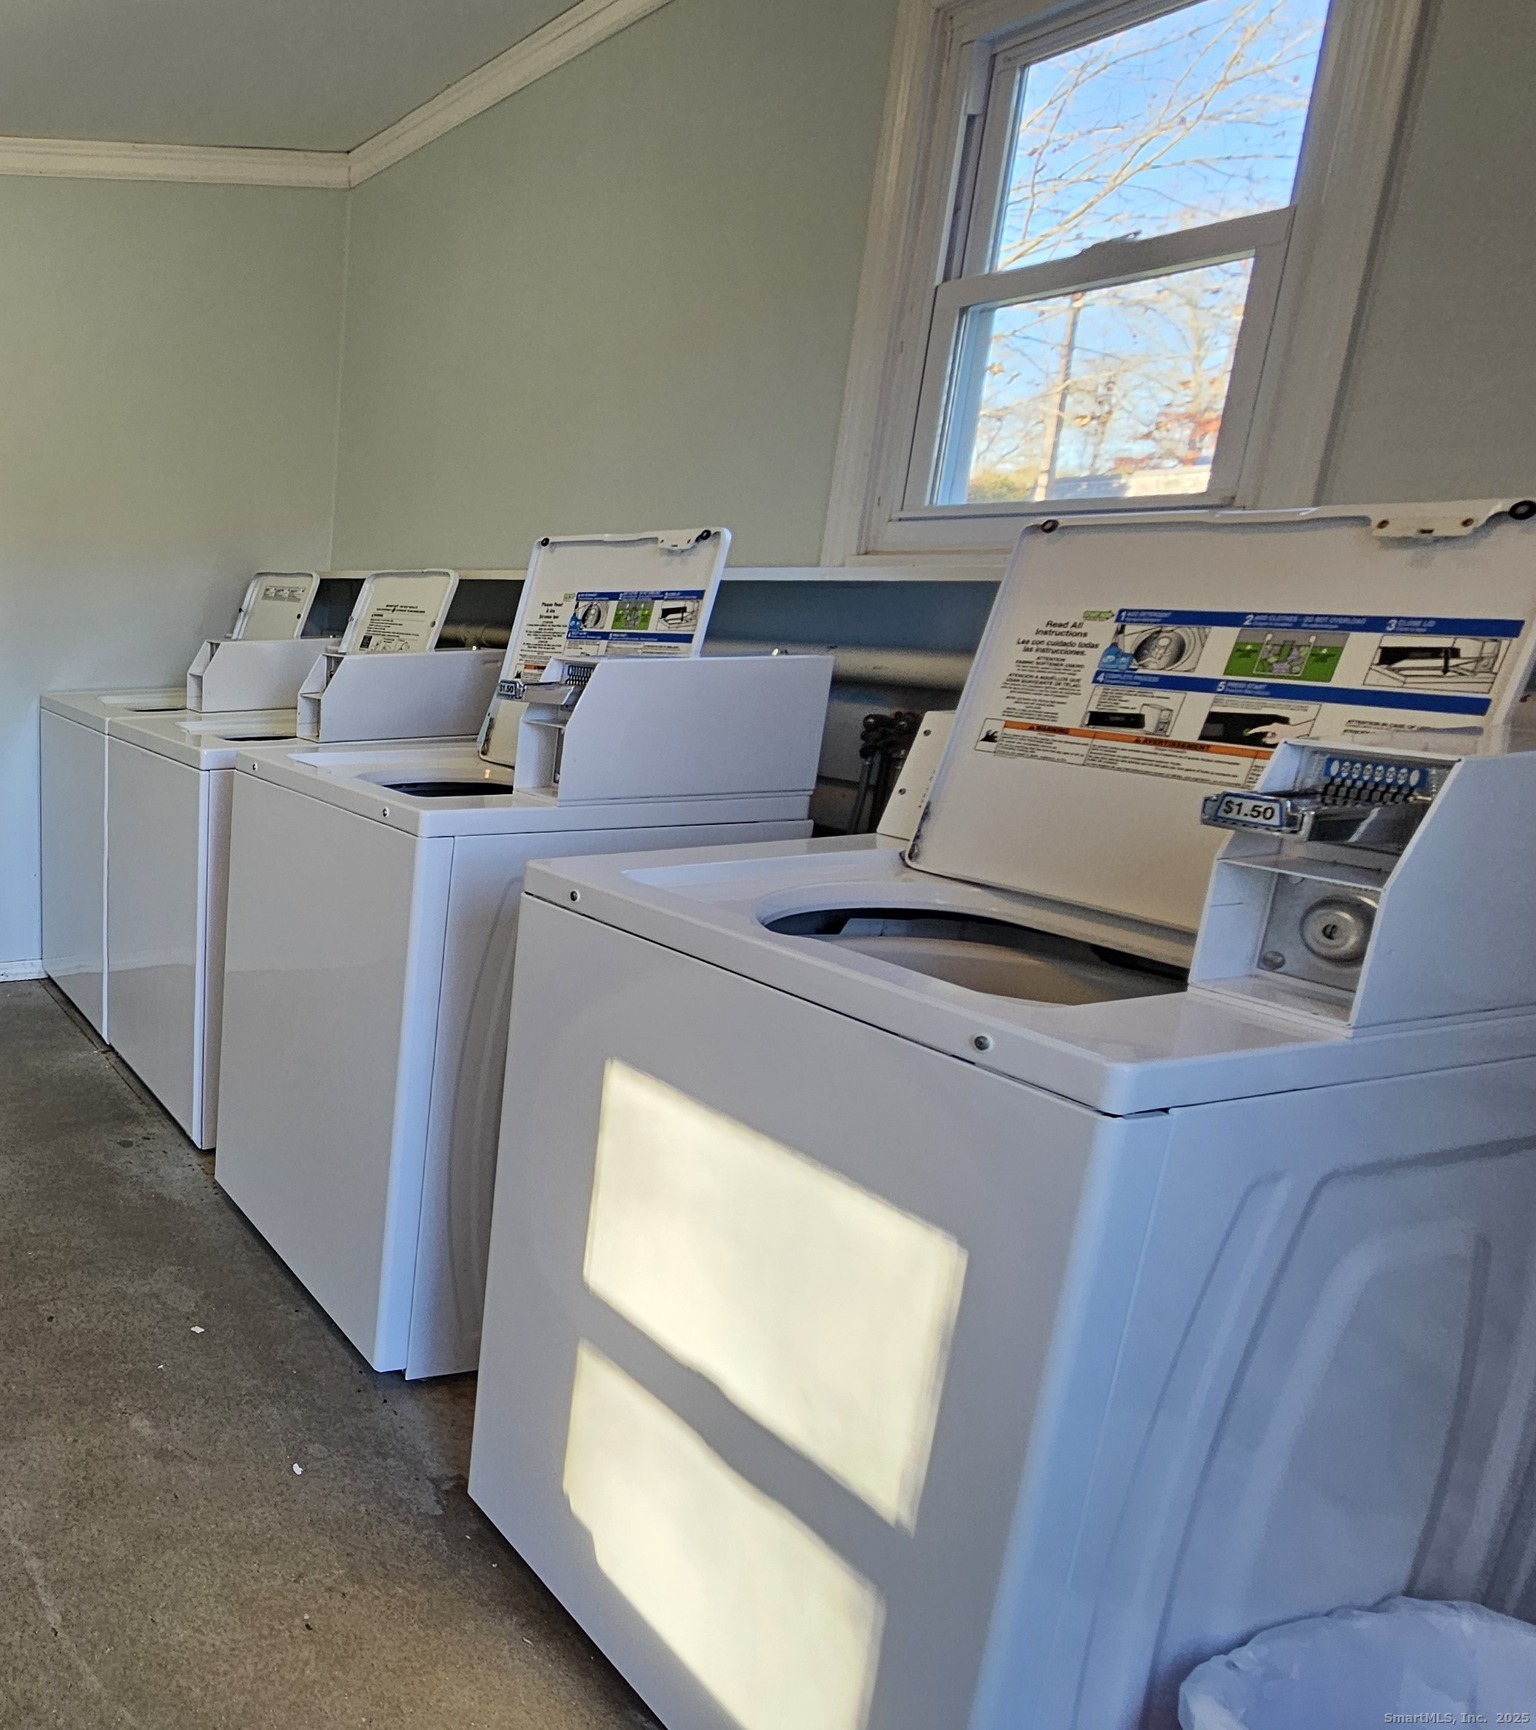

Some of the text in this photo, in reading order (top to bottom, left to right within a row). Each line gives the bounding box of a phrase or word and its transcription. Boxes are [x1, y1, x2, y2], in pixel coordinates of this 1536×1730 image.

[1120, 611, 1126, 620] 1
[1243, 614, 1254, 625] 2
[1046, 620, 1069, 628] Read
[1386, 620, 1396, 631] 3
[1035, 628, 1088, 638] Instructions
[1096, 672, 1105, 683] 4
[1216, 681, 1226, 692] 5
[1223, 800, 1275, 820] $1.50
